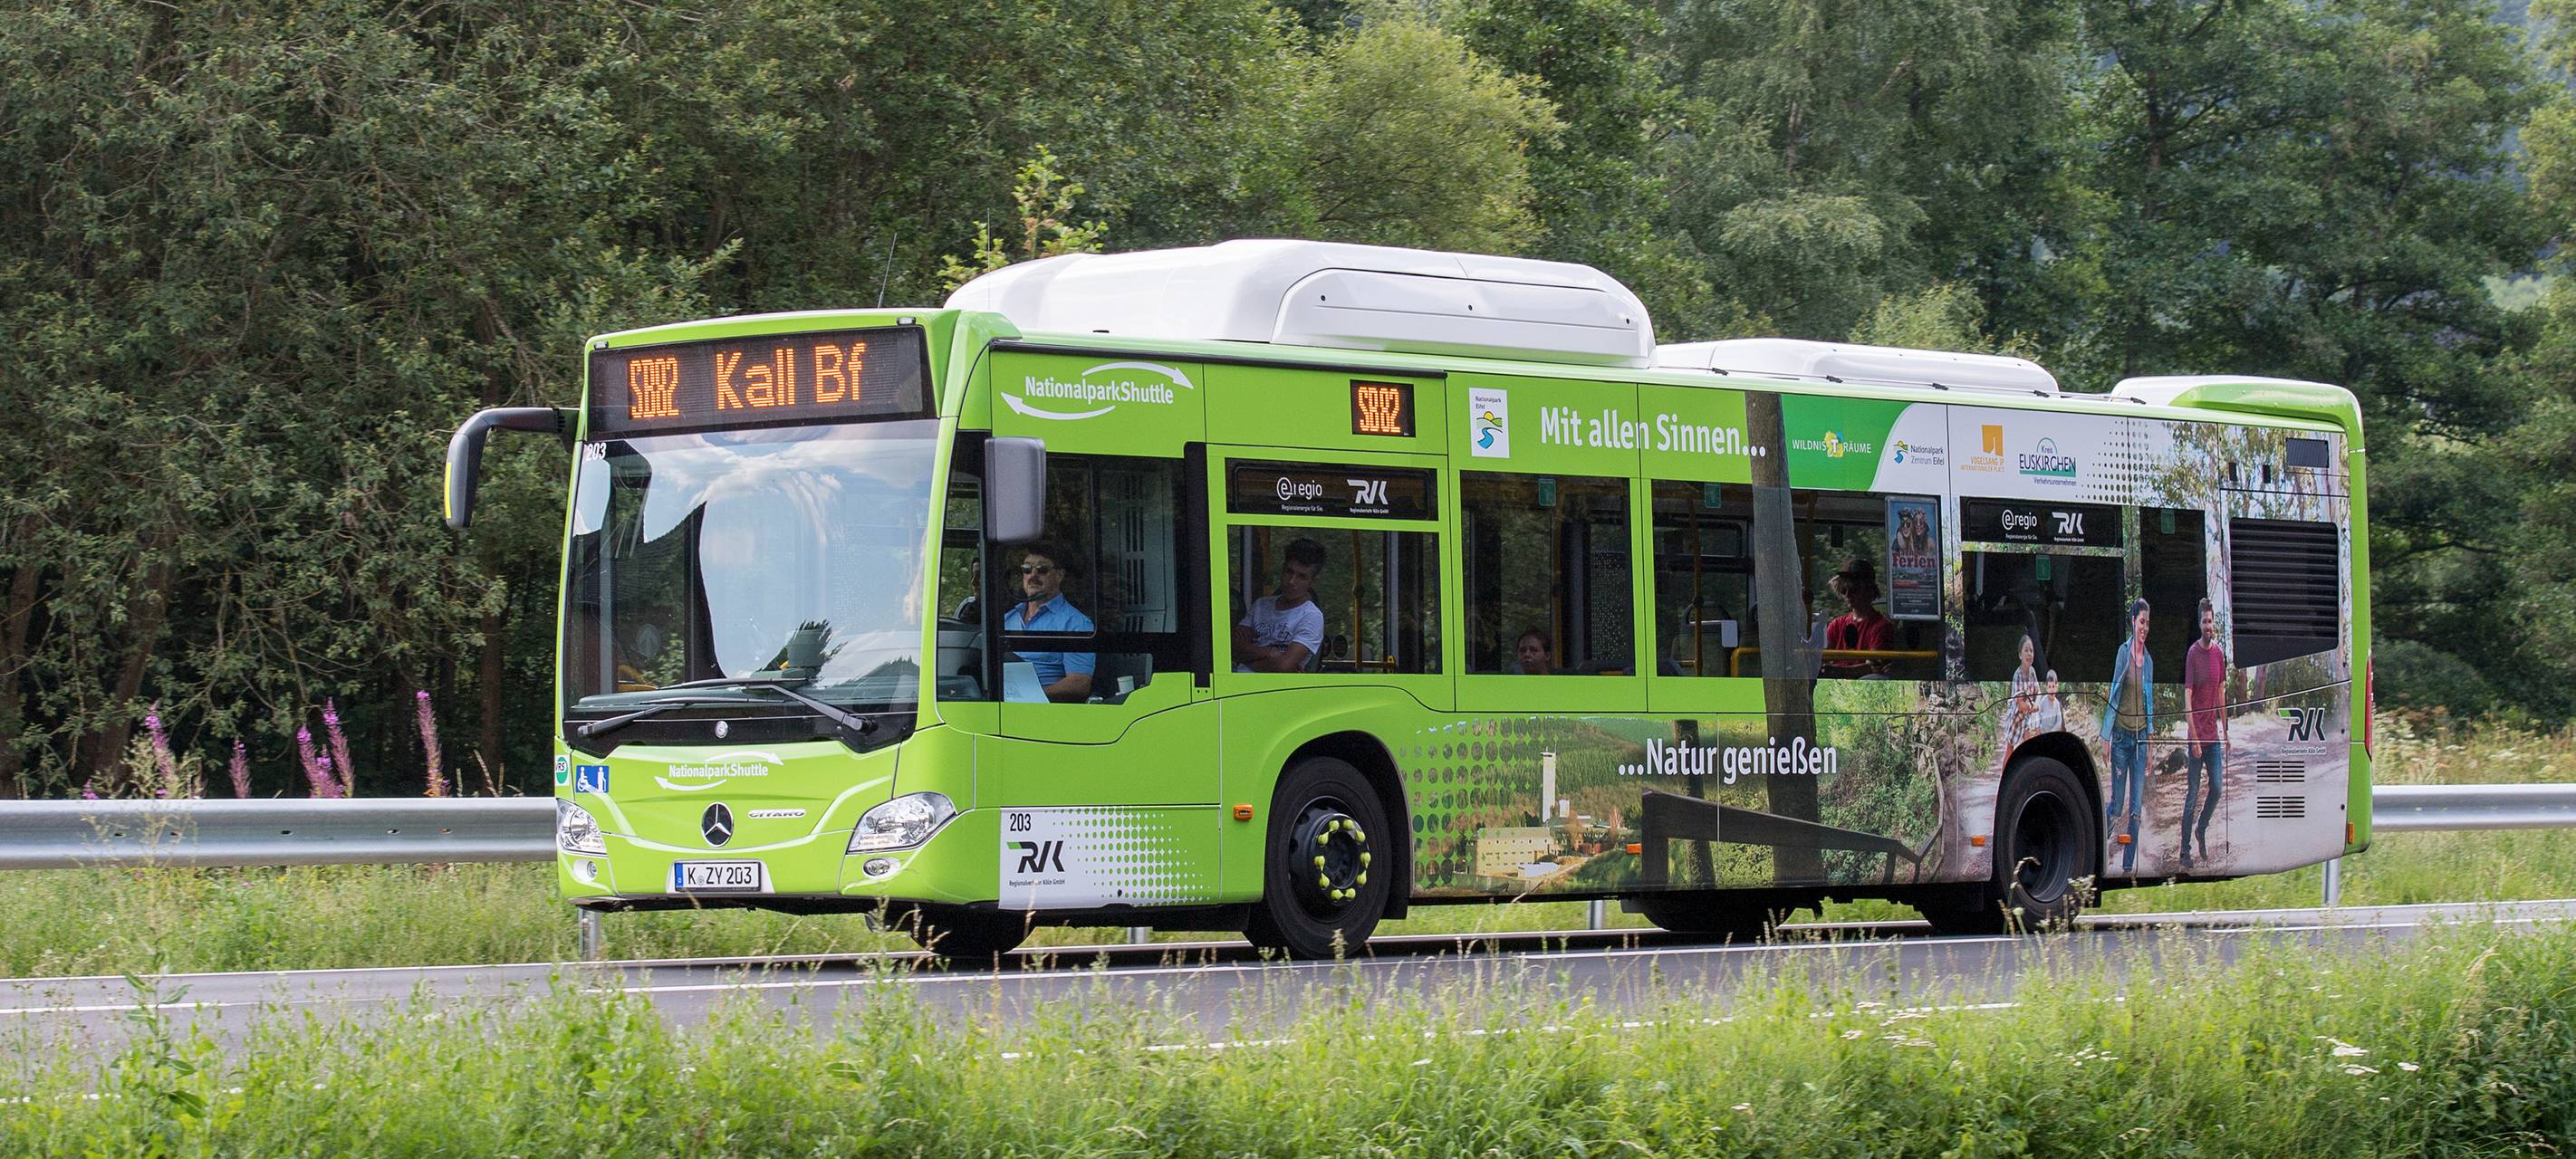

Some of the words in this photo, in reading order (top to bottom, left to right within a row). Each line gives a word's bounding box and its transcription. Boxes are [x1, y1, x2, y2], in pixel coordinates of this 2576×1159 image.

[630, 358, 679, 418] SB82
[716, 348, 796, 409] Kall
[815, 343, 866, 403] Bf
[1025, 376, 1174, 404] NationalparkShuttle
[1359, 387, 1400, 433] SB82
[1542, 407, 1582, 446] Mit
[1589, 408, 1649, 449] allen
[1657, 413, 1766, 457] Sinnen...
[1910, 445, 1944, 455] Nationalpark
[2042, 445, 2052, 454] Kreis
[1911, 456, 1932, 465] Zentrum
[1933, 457, 1945, 465] Eifel
[2019, 454, 2076, 472] EUSKIRCHEN
[1619, 738, 1718, 776] ...Natur
[1723, 736, 1837, 785] genießen
[669, 764, 768, 780] NationalparkShuttle
[1010, 813, 1032, 831] 203
[688, 867, 697, 885] K
[706, 867, 724, 885] ZY
[726, 867, 752, 885] 203
